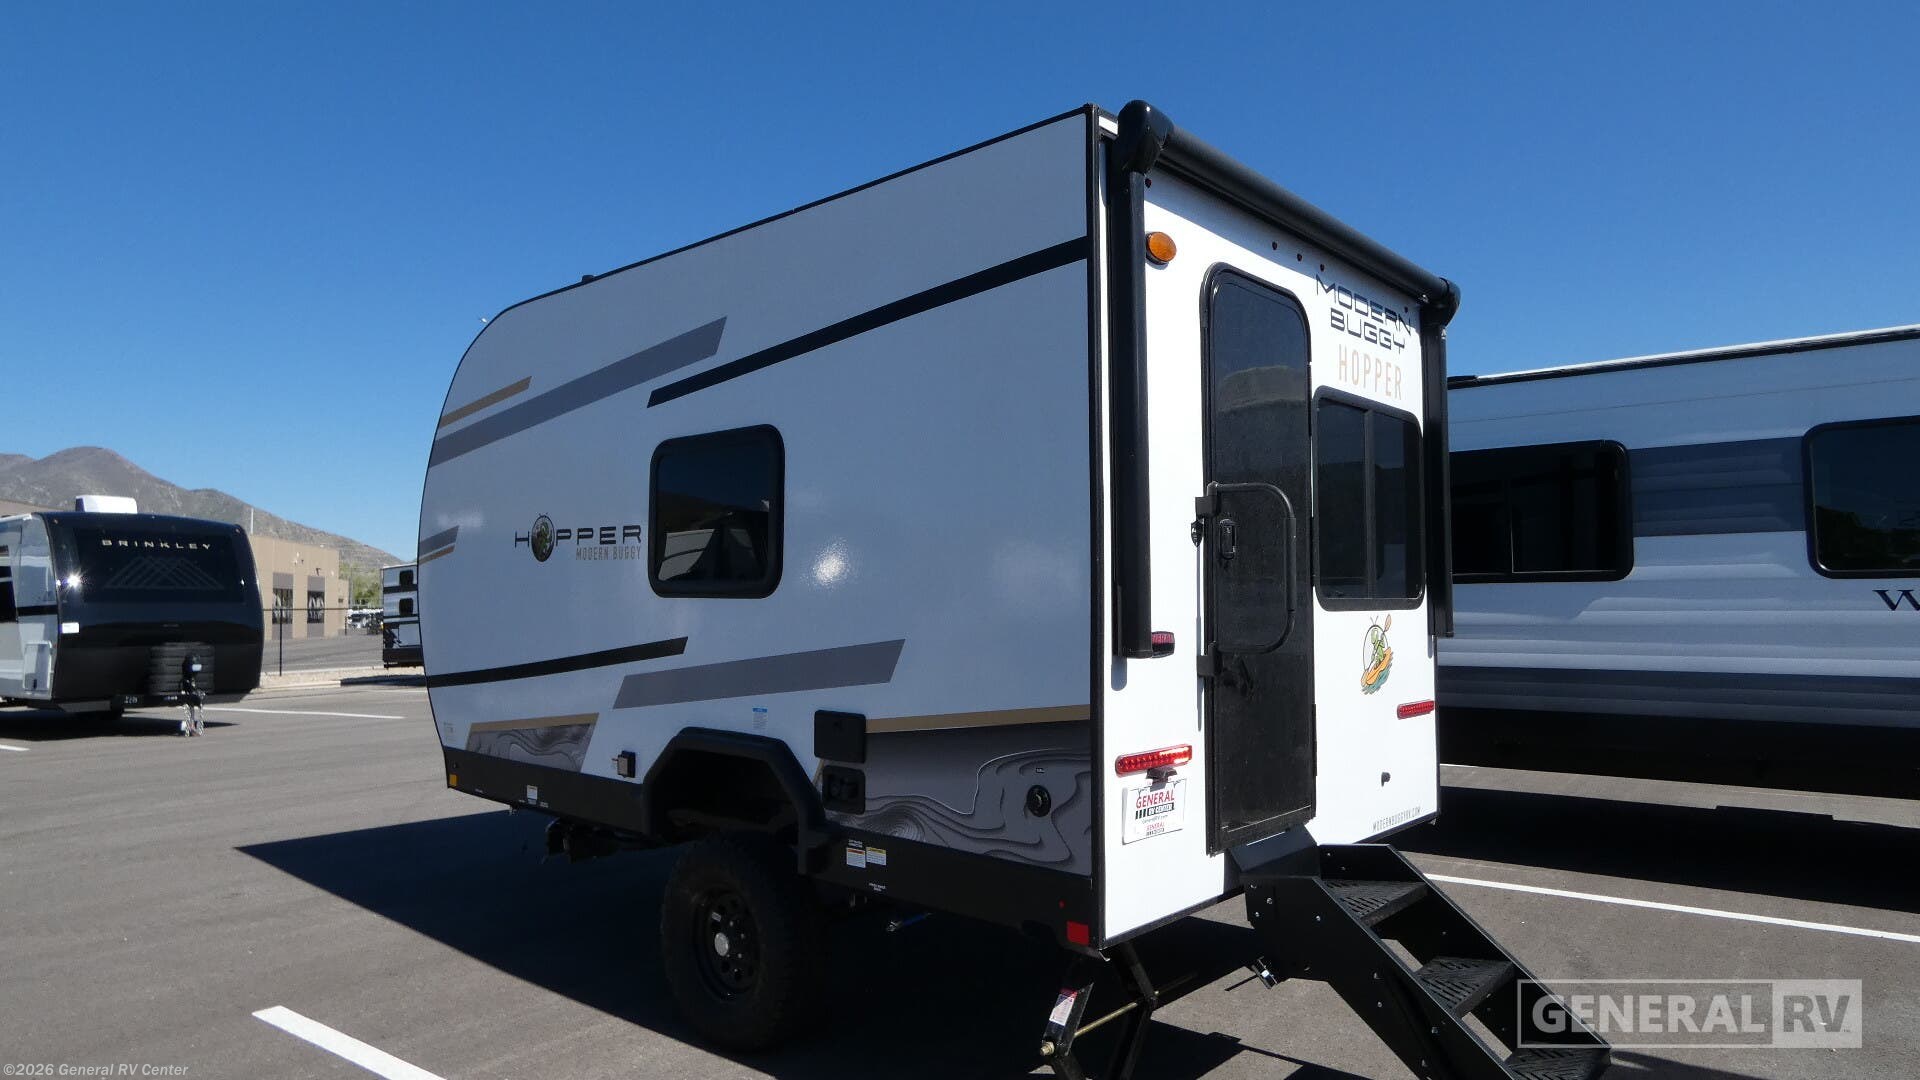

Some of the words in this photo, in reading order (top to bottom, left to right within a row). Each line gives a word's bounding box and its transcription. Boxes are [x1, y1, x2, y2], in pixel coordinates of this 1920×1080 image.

[1316, 274, 1412, 336] MODERN
[1331, 307, 1405, 354] BUGGY
[1338, 343, 1402, 400] HOPPER
[102, 539, 210, 549] BRINKLEY
[515, 514, 642, 562] HOPPER
[576, 547, 609, 560] MODERN
[613, 546, 641, 560] BUGGY
[1136, 789, 1174, 808] GENERAL
